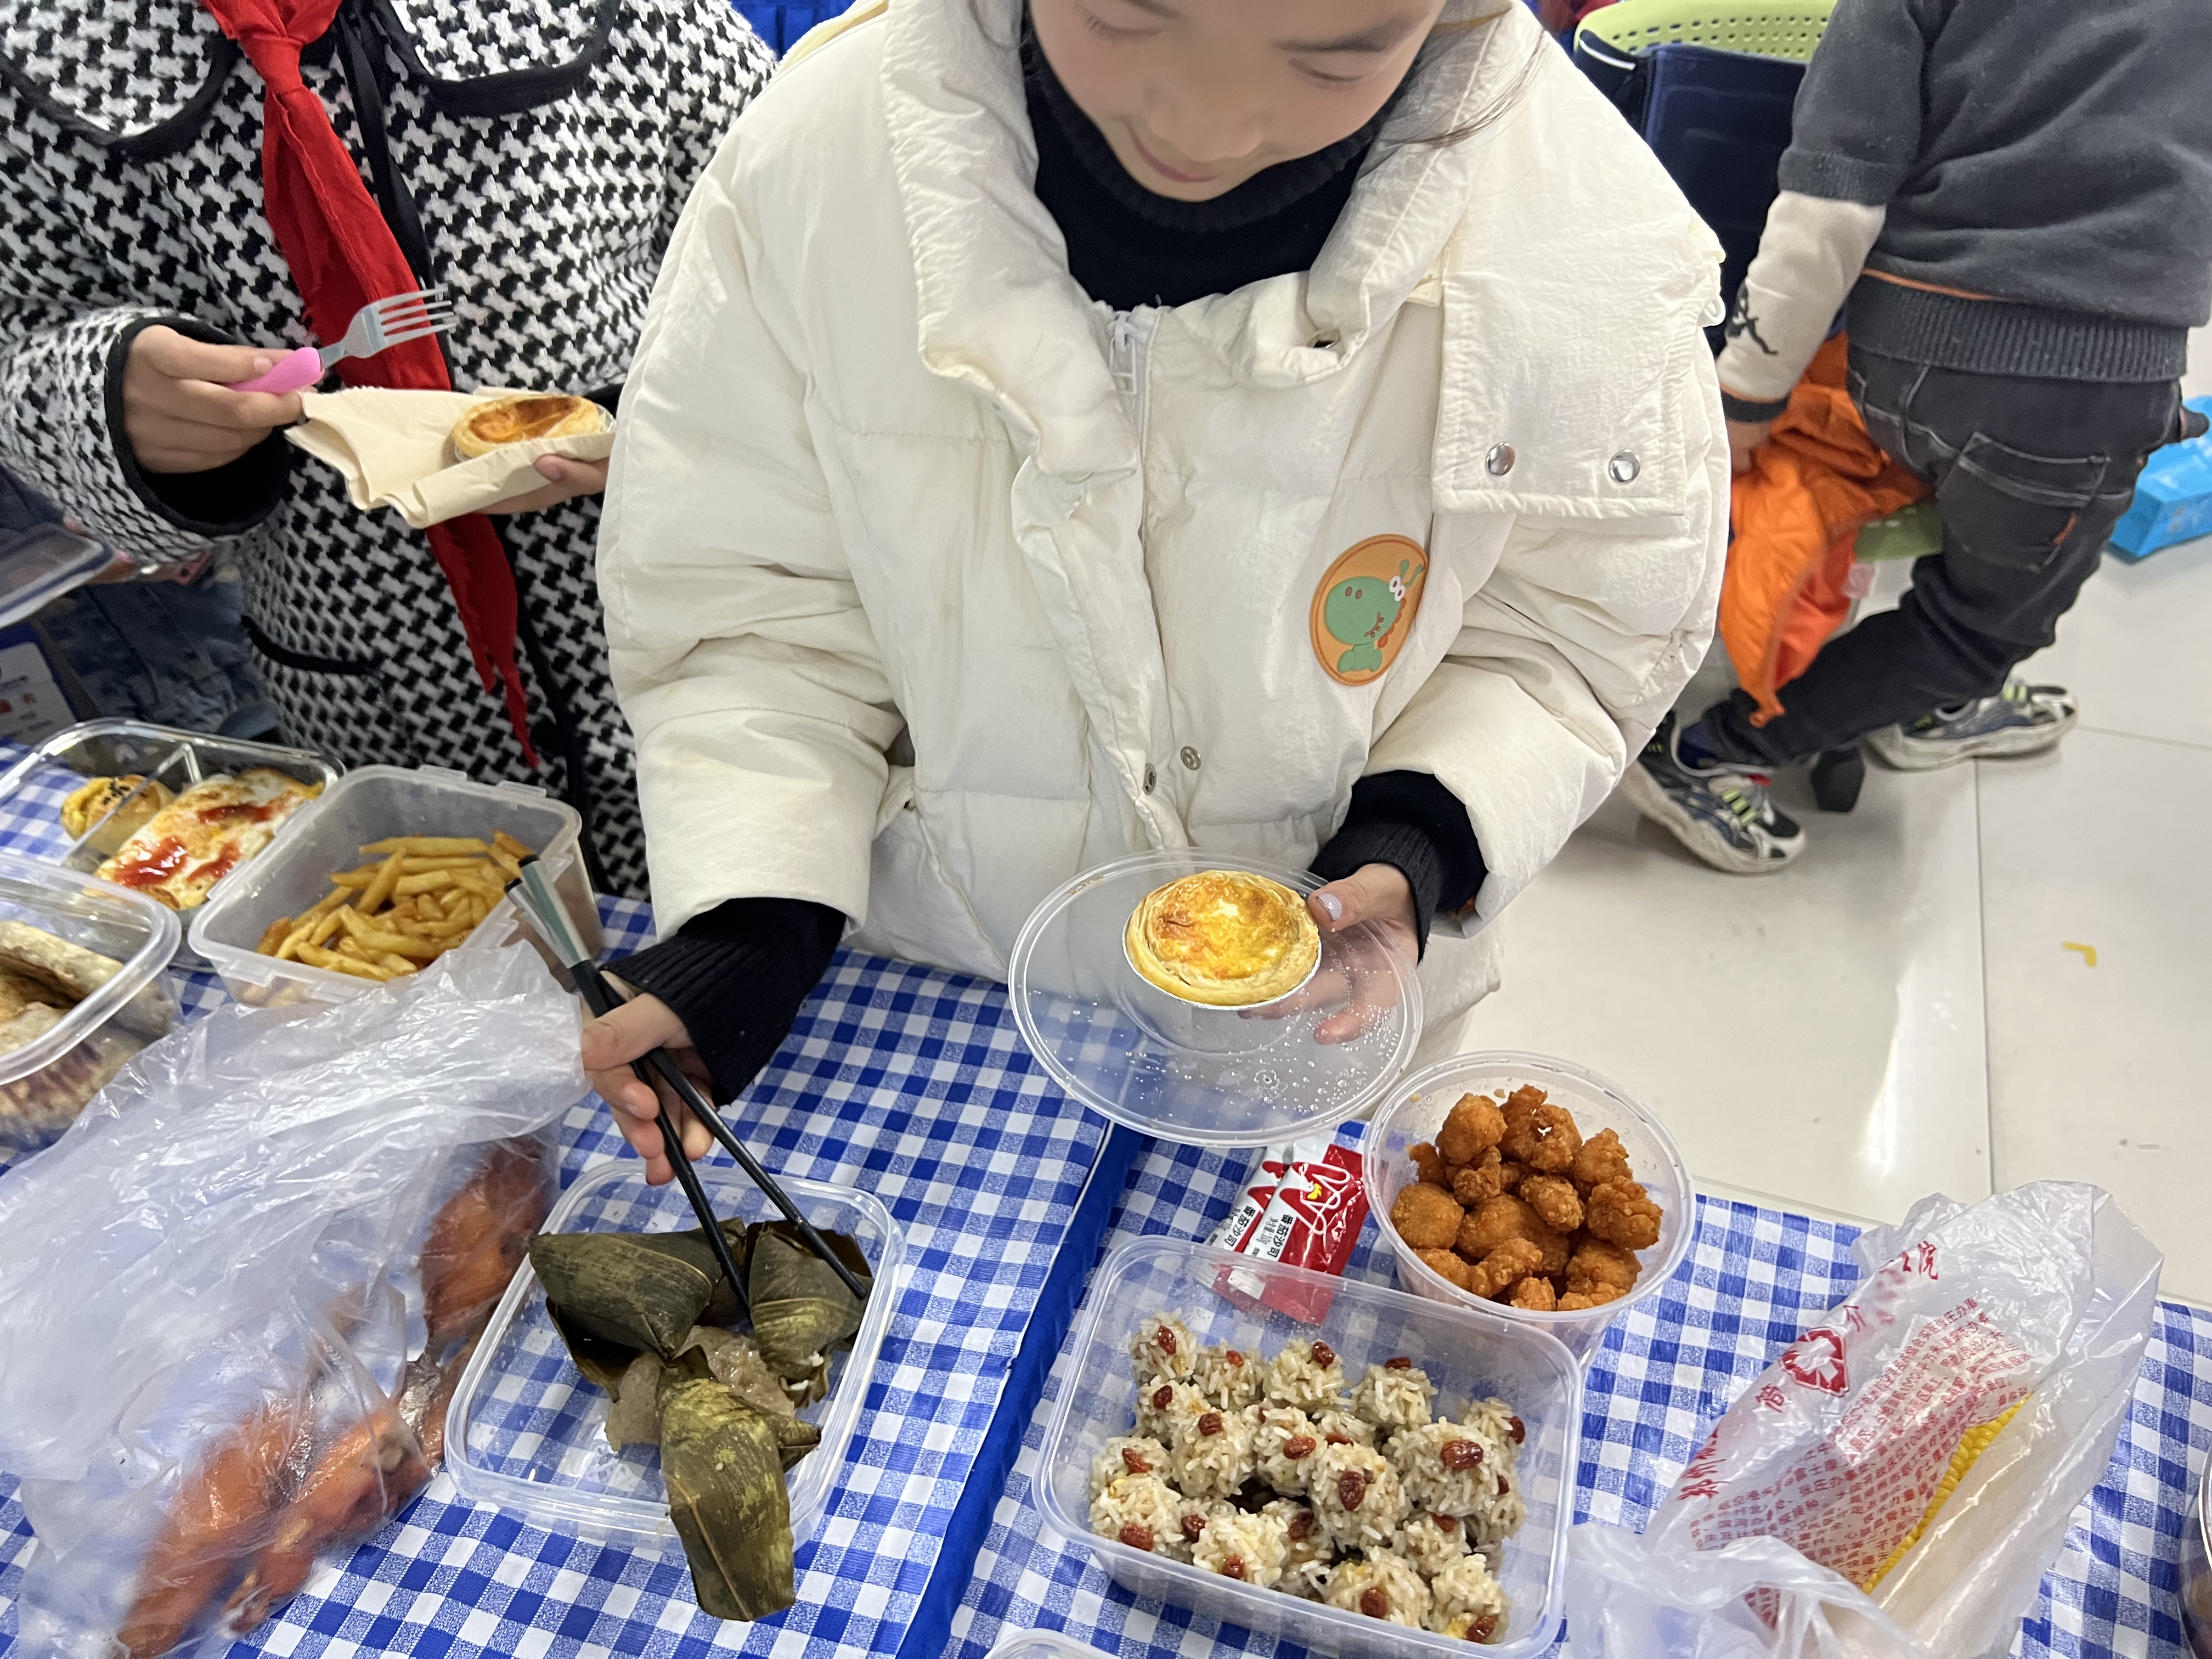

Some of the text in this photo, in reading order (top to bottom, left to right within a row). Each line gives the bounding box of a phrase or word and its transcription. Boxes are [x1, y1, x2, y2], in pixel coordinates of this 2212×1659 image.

[1224, 1206, 1256, 1246] 番茄沙司
[1267, 1214, 1294, 1257] 番茄沙司
